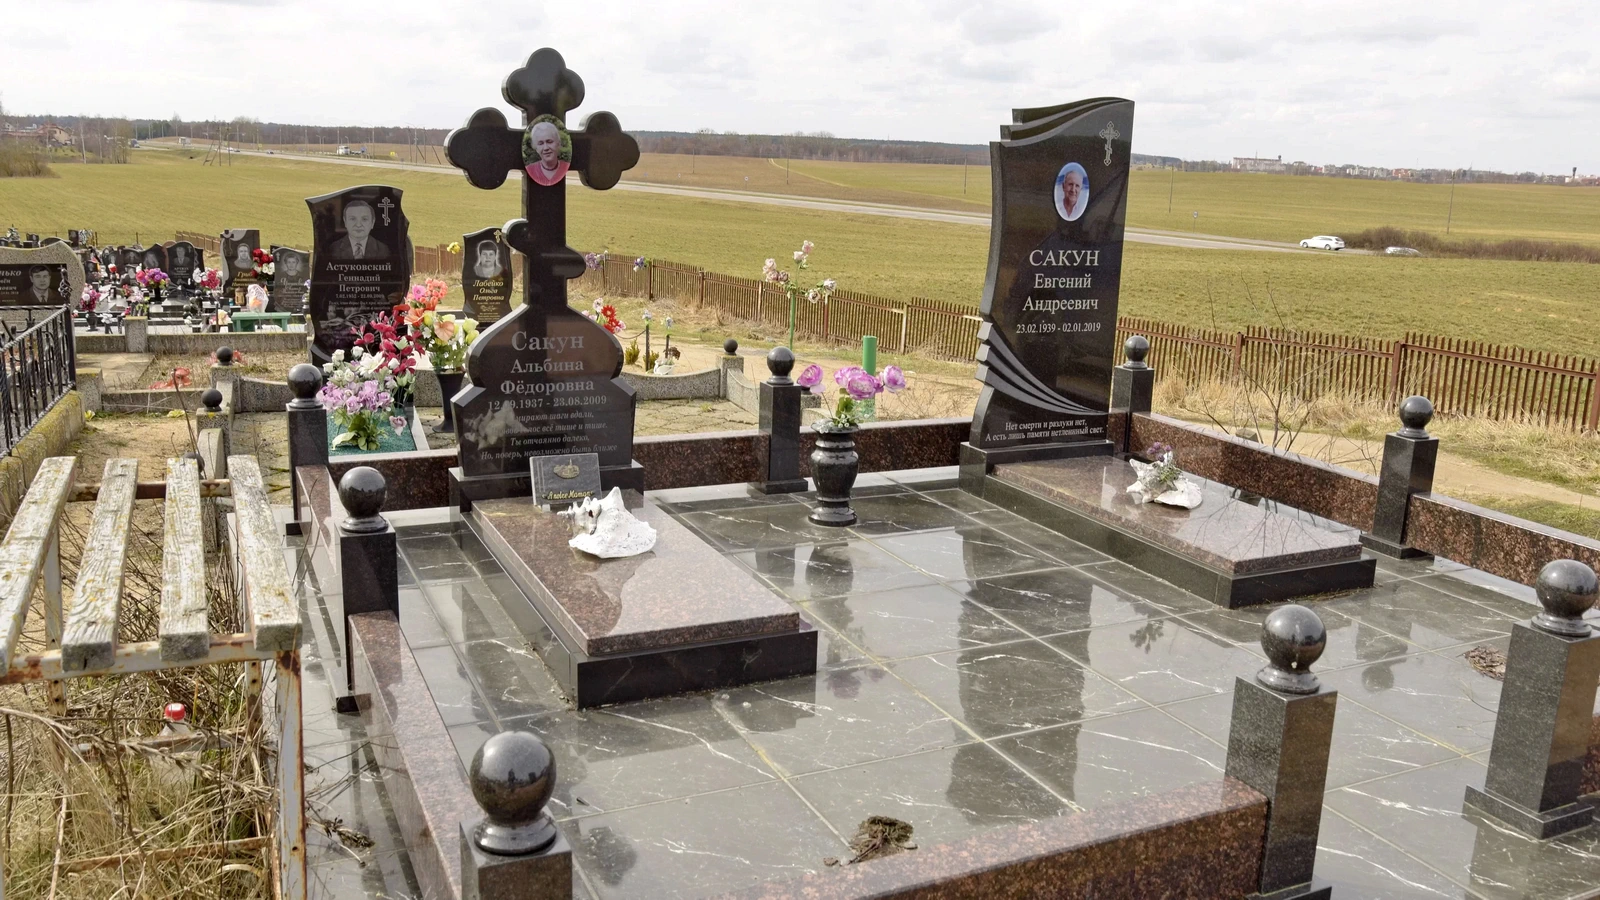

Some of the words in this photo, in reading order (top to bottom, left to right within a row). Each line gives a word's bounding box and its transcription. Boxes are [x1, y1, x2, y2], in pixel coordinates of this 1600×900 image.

[1029, 249, 1100, 267] САКУН
[326, 262, 392, 273] Астуковский
[338, 274, 381, 282] Геннадий
[1033, 273, 1092, 289] Евгений
[339, 284, 381, 293] Петрович
[1022, 295, 1099, 315] Андреевич
[1016, 323, 1056, 334] 23.02.1939
[1062, 322, 1100, 333] 02.01.2019
[511, 331, 584, 353] Сакун
[510, 359, 584, 374] Альбина
[500, 380, 594, 396] Фёдоровна
[553, 396, 607, 407] 23.08.2009
[541, 424, 554, 432] всё
[1005, 422, 1018, 430] Нет
[1019, 422, 1042, 431] смерти
[1048, 421, 1074, 429] разлуки
[985, 433, 991, 441] А
[1007, 432, 1025, 440] лишь
[1026, 430, 1050, 439] памяти
[510, 437, 522, 446] Ты
[522, 437, 562, 445] отчаянно
[481, 451, 494, 460] Но,
[495, 451, 522, 460] поверь,
[524, 446, 570, 457] невозможно
[571, 444, 592, 453] быть
[593, 443, 618, 452] ближе
